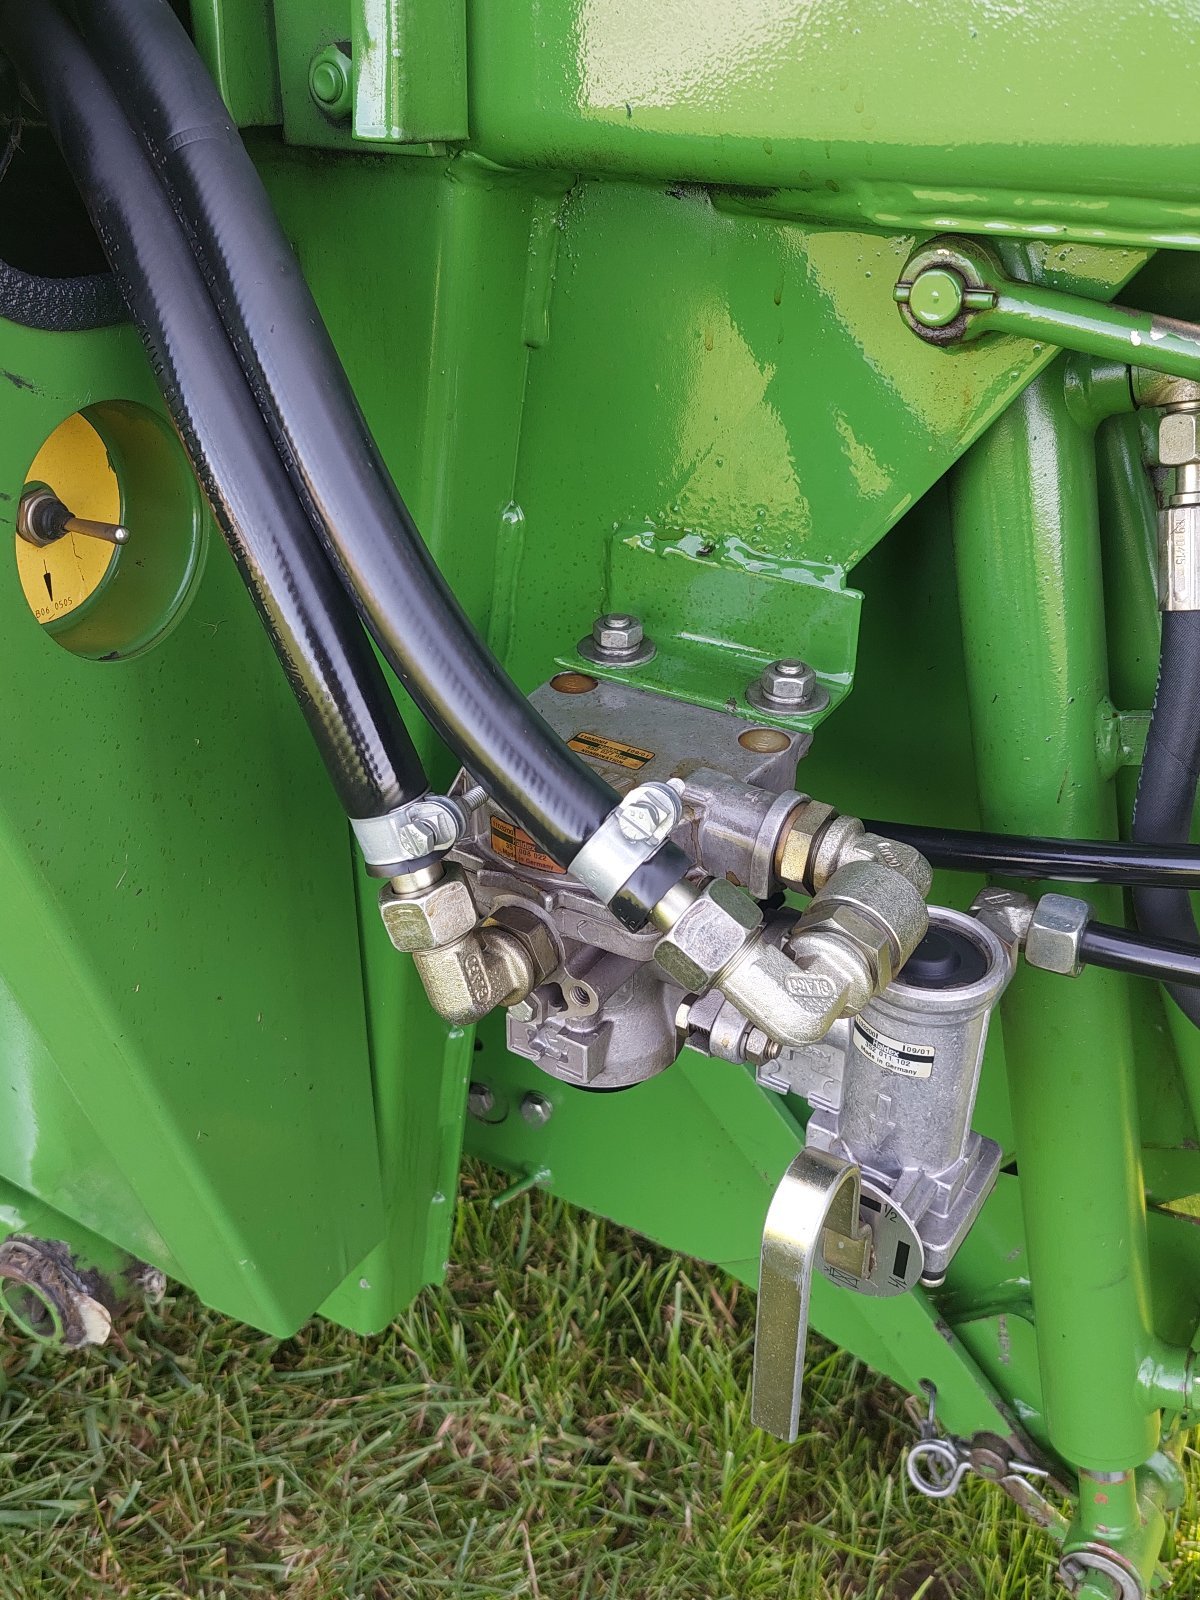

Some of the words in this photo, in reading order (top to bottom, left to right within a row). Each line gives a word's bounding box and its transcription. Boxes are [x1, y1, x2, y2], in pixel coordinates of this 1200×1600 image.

[54, 596, 73, 610] 0505
[525, 858, 554, 870] Germany
[873, 1038, 900, 1058] Haldex
[861, 1045, 875, 1059] Made
[876, 1057, 883, 1065] in
[885, 1061, 918, 1076] Germany
[878, 1050, 892, 1061] 011
[896, 1058, 911, 1067] 102
[883, 1203, 898, 1224] 1/2
